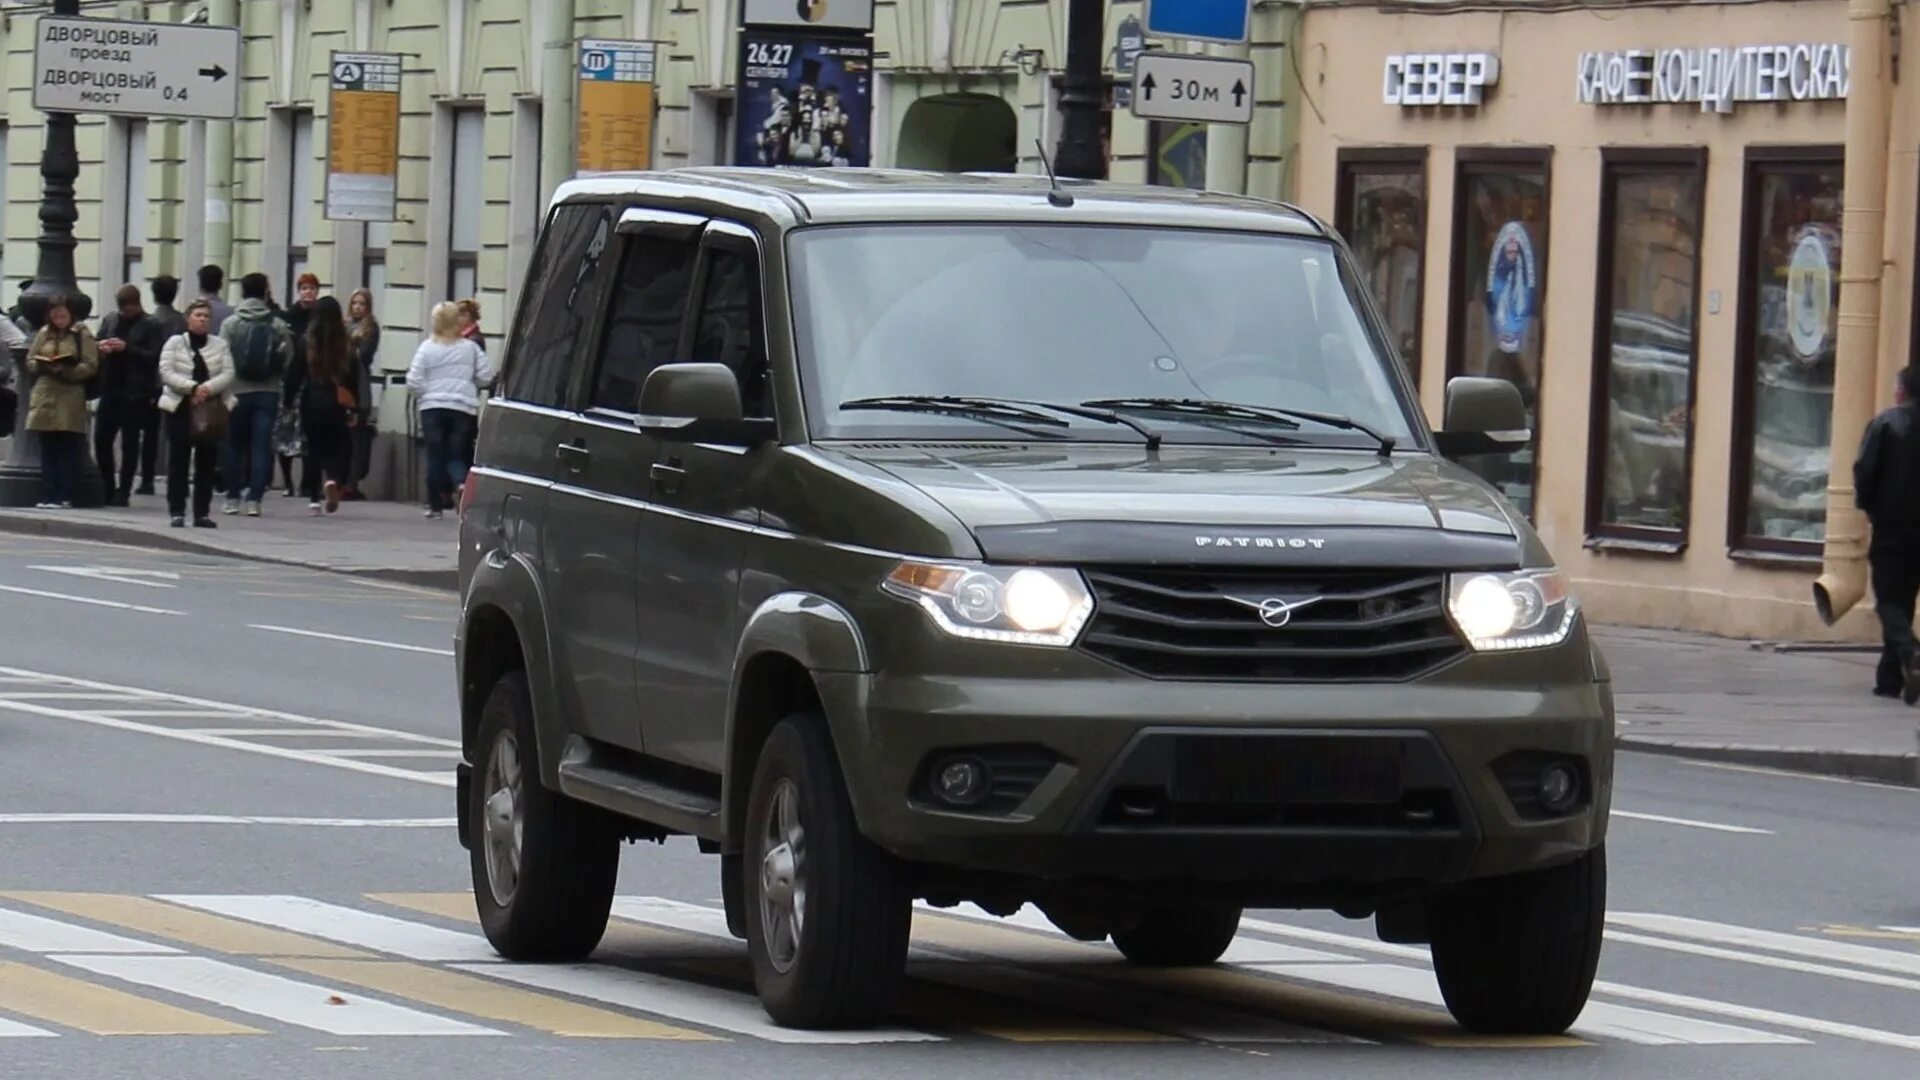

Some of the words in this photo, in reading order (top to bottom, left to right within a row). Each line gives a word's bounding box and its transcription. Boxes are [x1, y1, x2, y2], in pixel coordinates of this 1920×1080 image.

[45, 25, 159, 47] ДВОРЦОВЫЙ
[69, 46, 131, 62] проезд
[43, 69, 156, 90] ДВОРЦОВЫЙ
[1382, 53, 1494, 106] СЕВЕР
[79, 90, 121, 104] мост
[1195, 536, 1325, 548] PATRIOT
